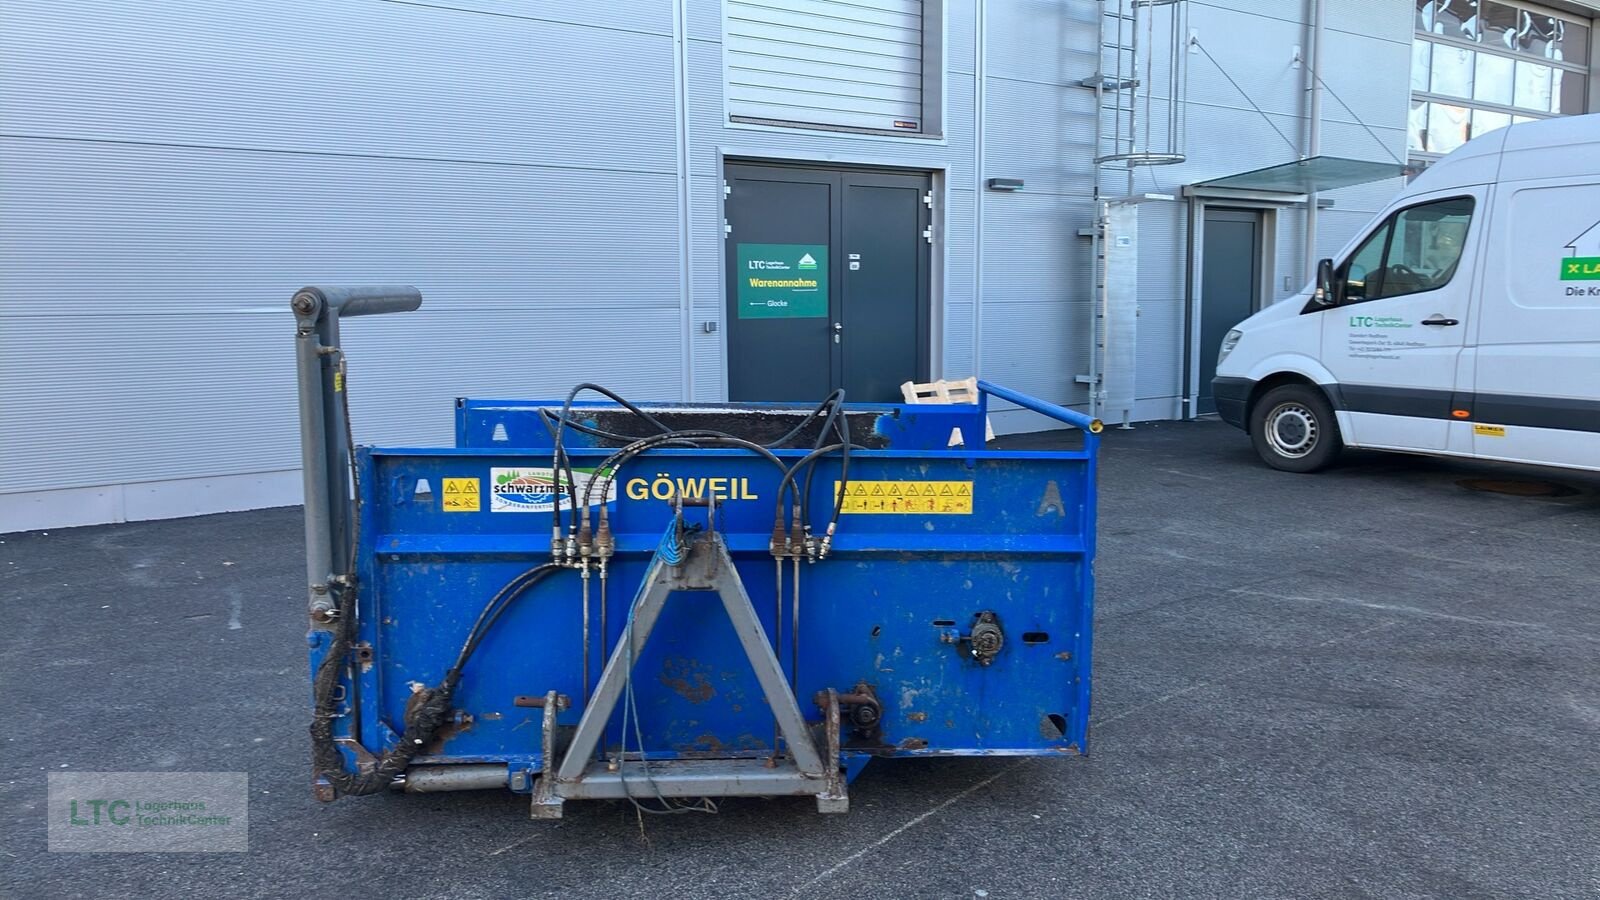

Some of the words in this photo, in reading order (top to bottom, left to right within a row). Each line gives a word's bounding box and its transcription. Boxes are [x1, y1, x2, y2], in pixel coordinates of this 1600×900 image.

[749, 260, 766, 269] LTC
[749, 277, 817, 288] Warenannahme
[1565, 286, 1585, 296] Die
[1349, 316, 1373, 328] LTC
[626, 473, 758, 500] GÖWEIL
